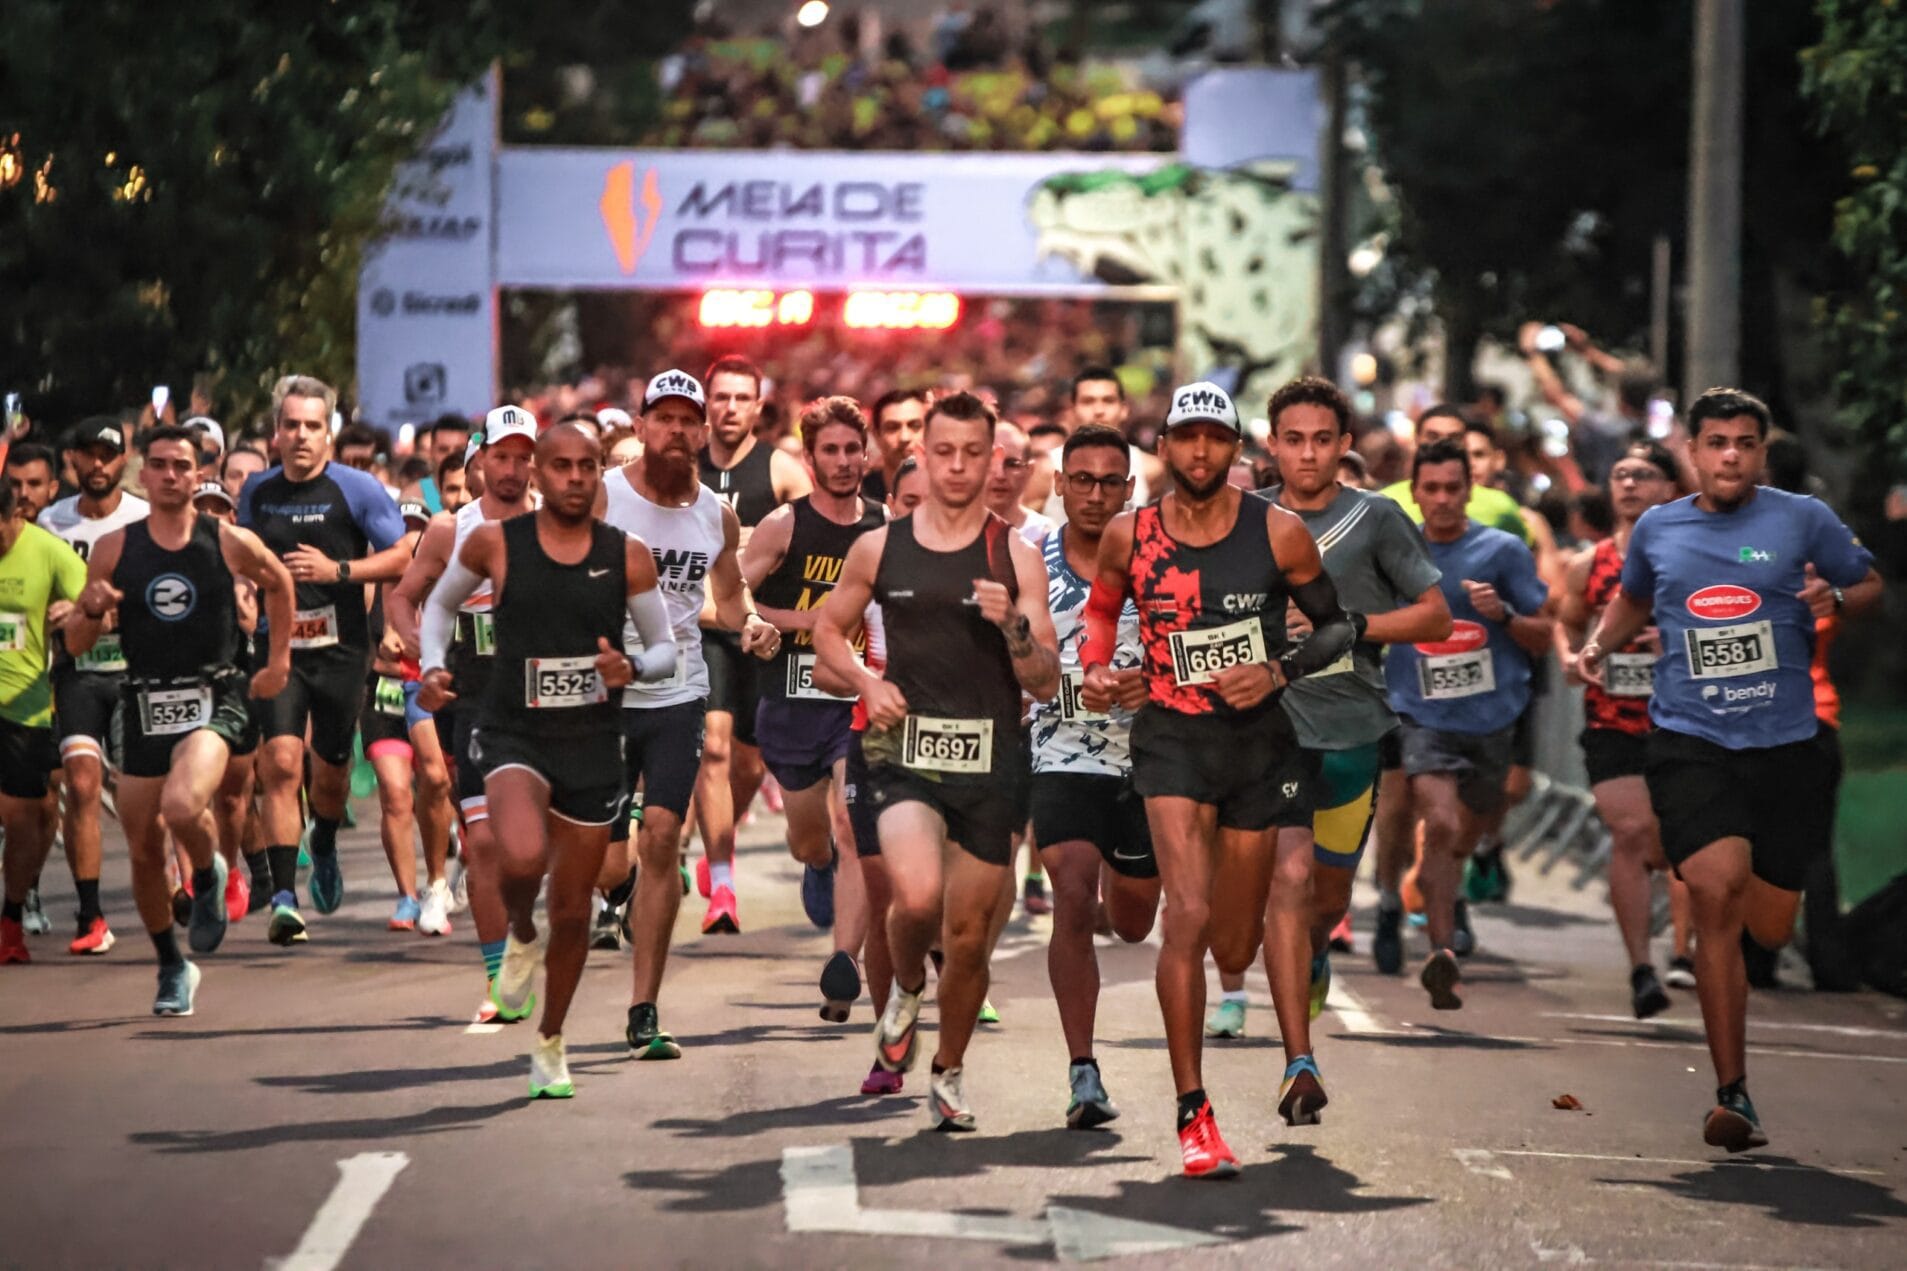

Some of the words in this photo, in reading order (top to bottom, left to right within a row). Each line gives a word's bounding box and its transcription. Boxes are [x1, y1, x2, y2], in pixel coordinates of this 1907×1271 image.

[675, 181, 824, 219] MEIA
[833, 182, 926, 221] DE
[672, 229, 926, 273] CURITA
[656, 375, 697, 393] CWB
[1178, 390, 1227, 410] CWB
[652, 548, 708, 581] WB
[803, 554, 844, 583] VIV
[1189, 641, 1253, 672] 6655
[1703, 639, 1760, 666] 5581
[541, 672, 597, 697] 5525
[1724, 681, 1777, 702] bendy
[153, 703, 200, 724] 5523
[920, 735, 980, 760] 6697
